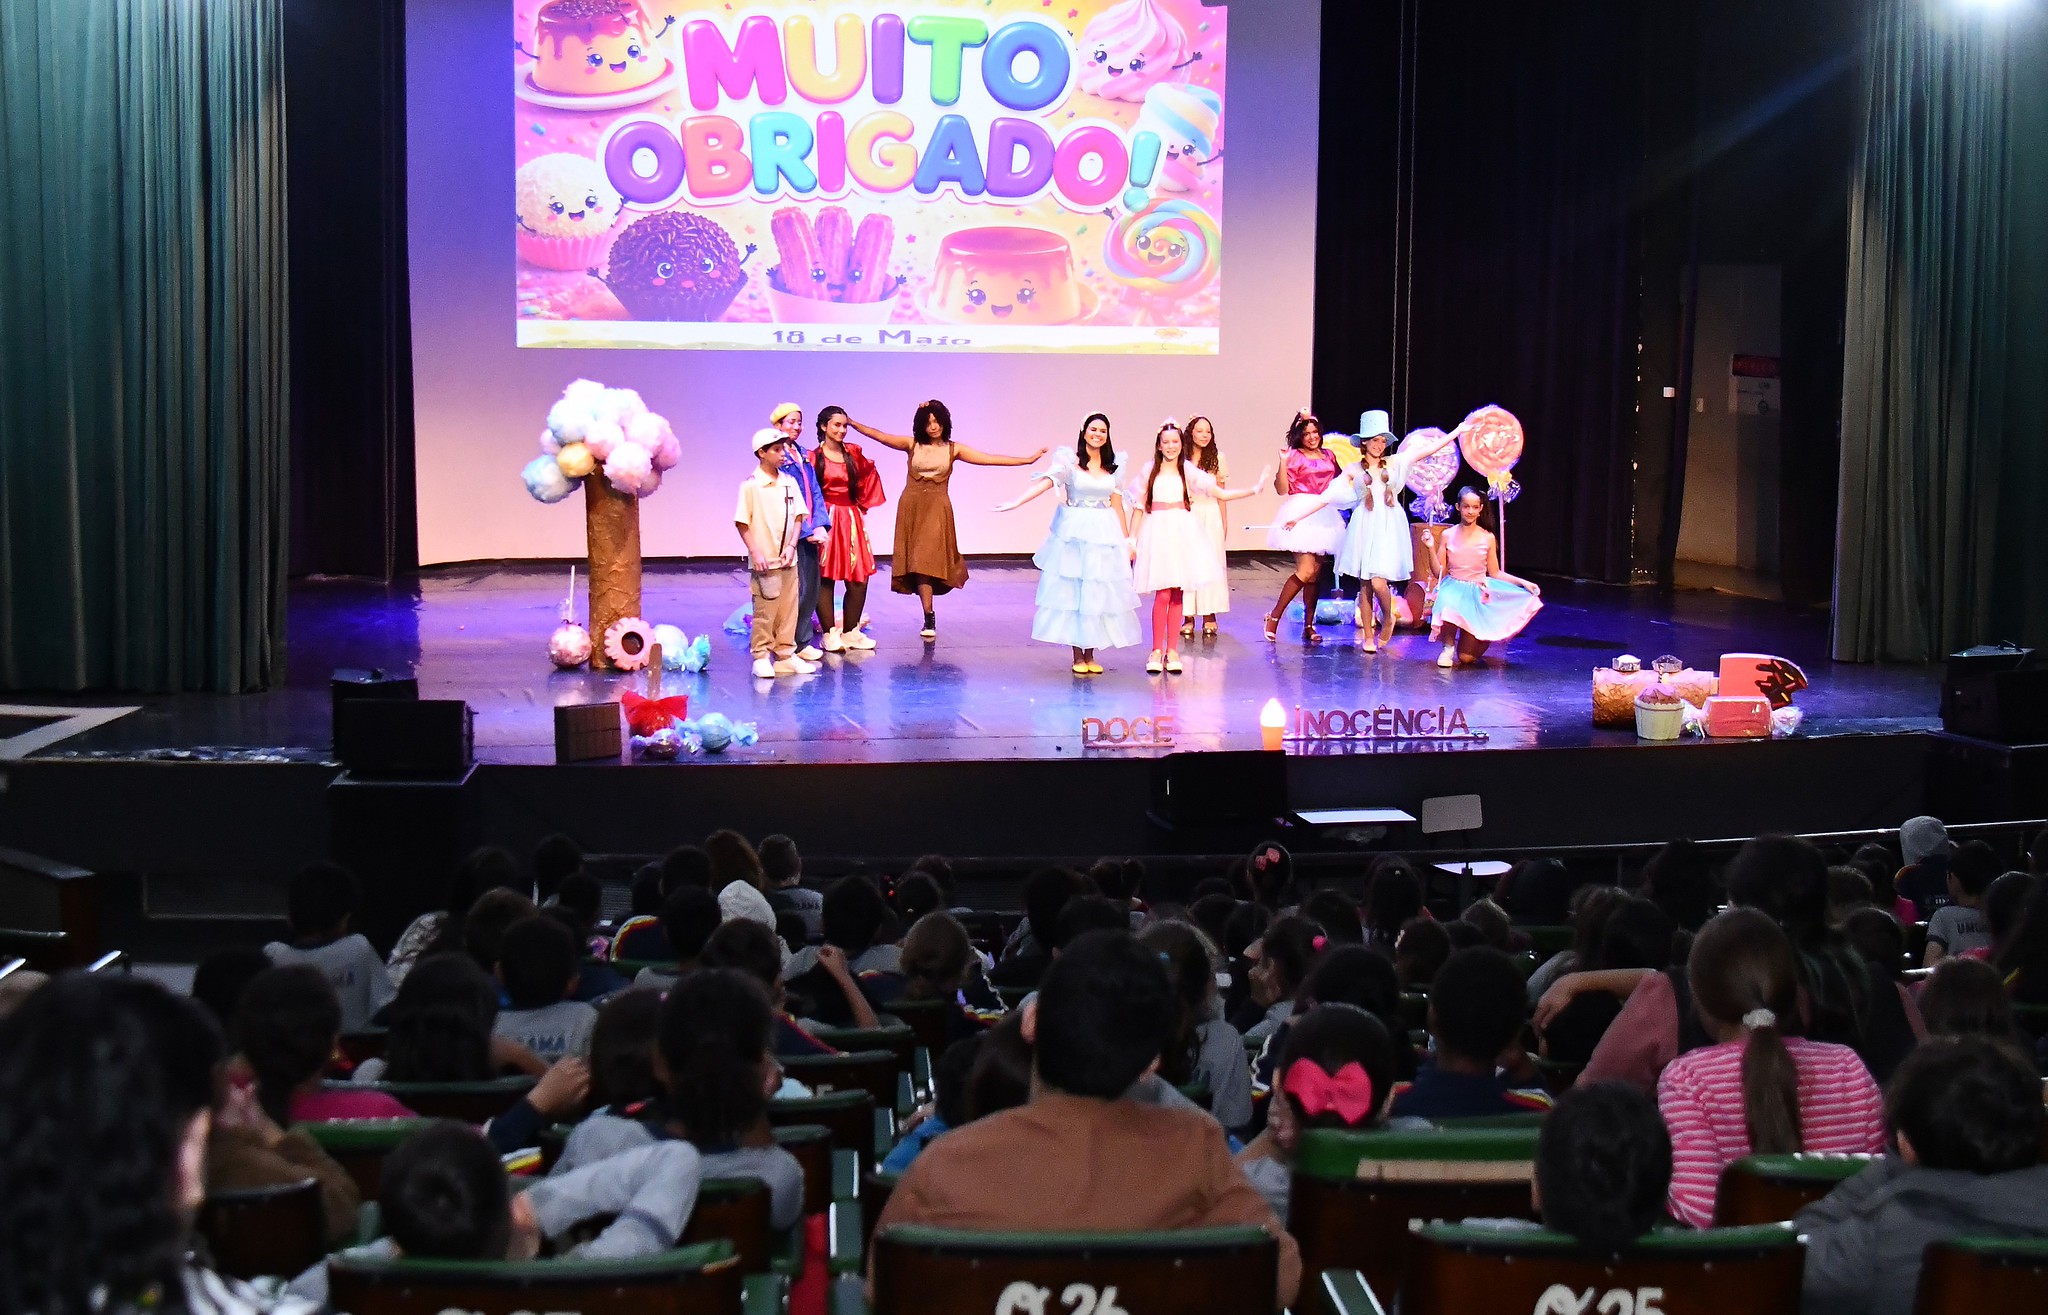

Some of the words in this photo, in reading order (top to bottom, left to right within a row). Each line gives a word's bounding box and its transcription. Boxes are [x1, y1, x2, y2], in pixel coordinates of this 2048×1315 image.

[681, 13, 1070, 111] MUITO
[604, 110, 1162, 212] OBRIGADO!
[772, 330, 805, 345] 18
[821, 334, 863, 344] de
[878, 330, 971, 345] Maio
[1082, 716, 1175, 744] DOCE
[1294, 704, 1470, 736] INOCÊNCIA
